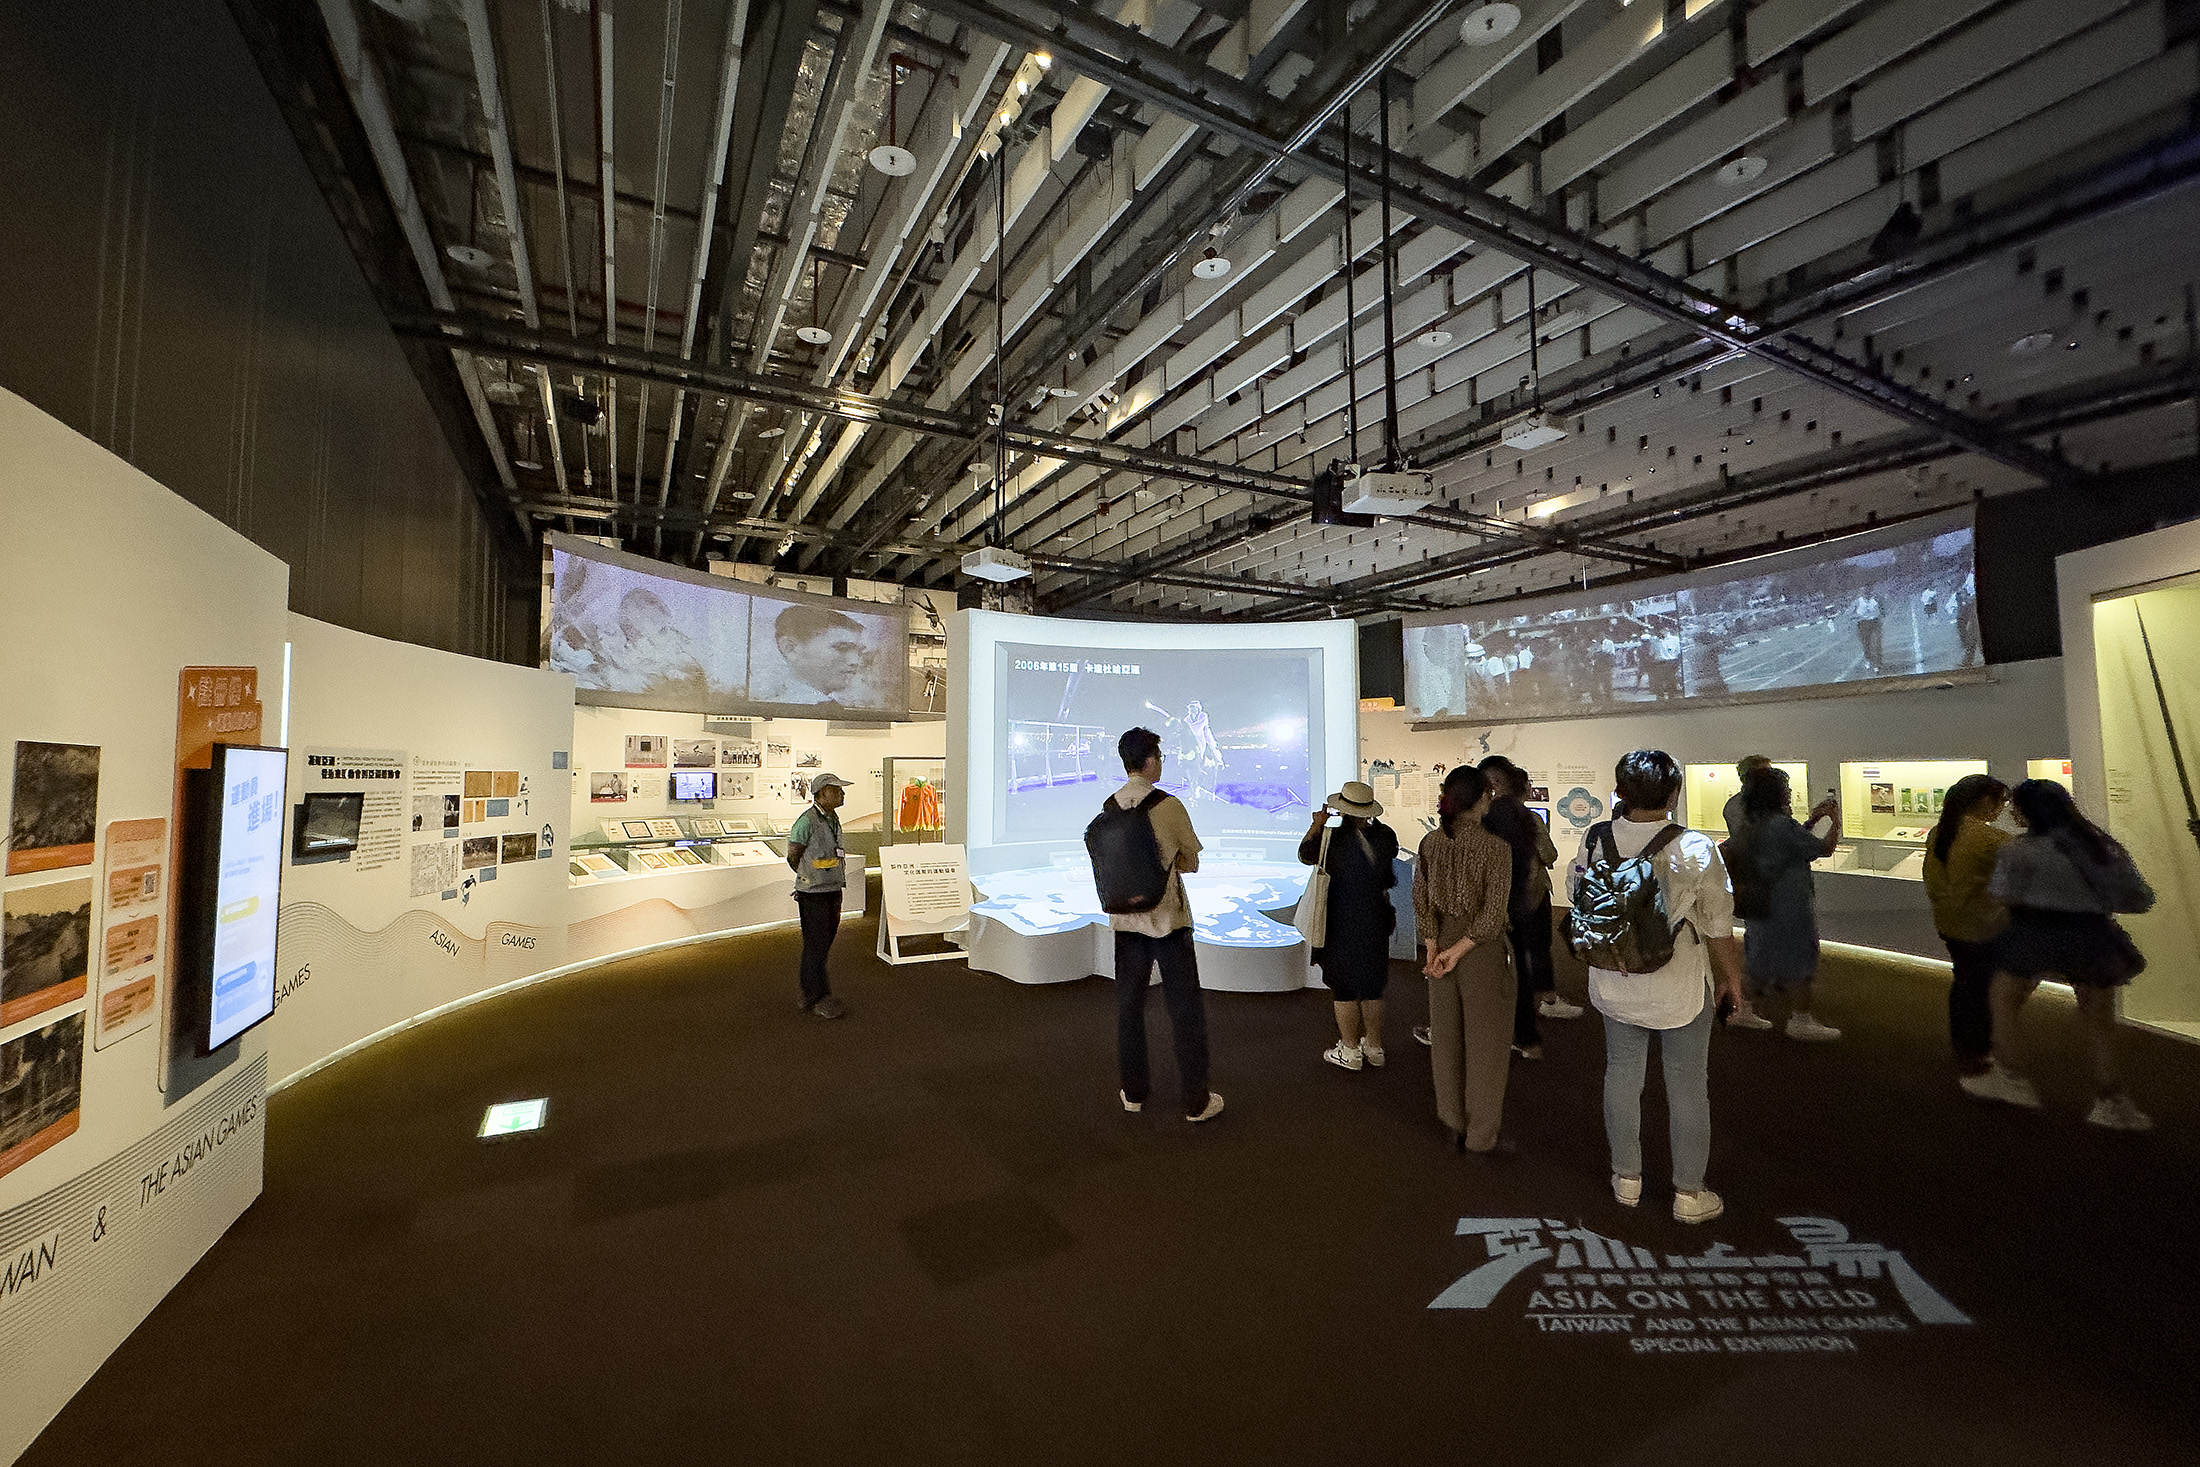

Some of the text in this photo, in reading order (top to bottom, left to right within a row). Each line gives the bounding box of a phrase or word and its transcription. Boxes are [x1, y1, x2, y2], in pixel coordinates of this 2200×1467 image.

[429, 928, 537, 957] ASIAN GAMES
[92, 1205, 108, 1243] &
[140, 1162, 169, 1209] THE
[170, 1126, 216, 1184] ASIAN
[216, 1094, 258, 1147] GAMES
[1528, 1289, 1877, 1310] ASIA ON THE FIELD
[1524, 1314, 1909, 1333] TAIWAN AND THE ASIAN GAMES
[1629, 1335, 1858, 1354] SPECIAL EXHIBITION
